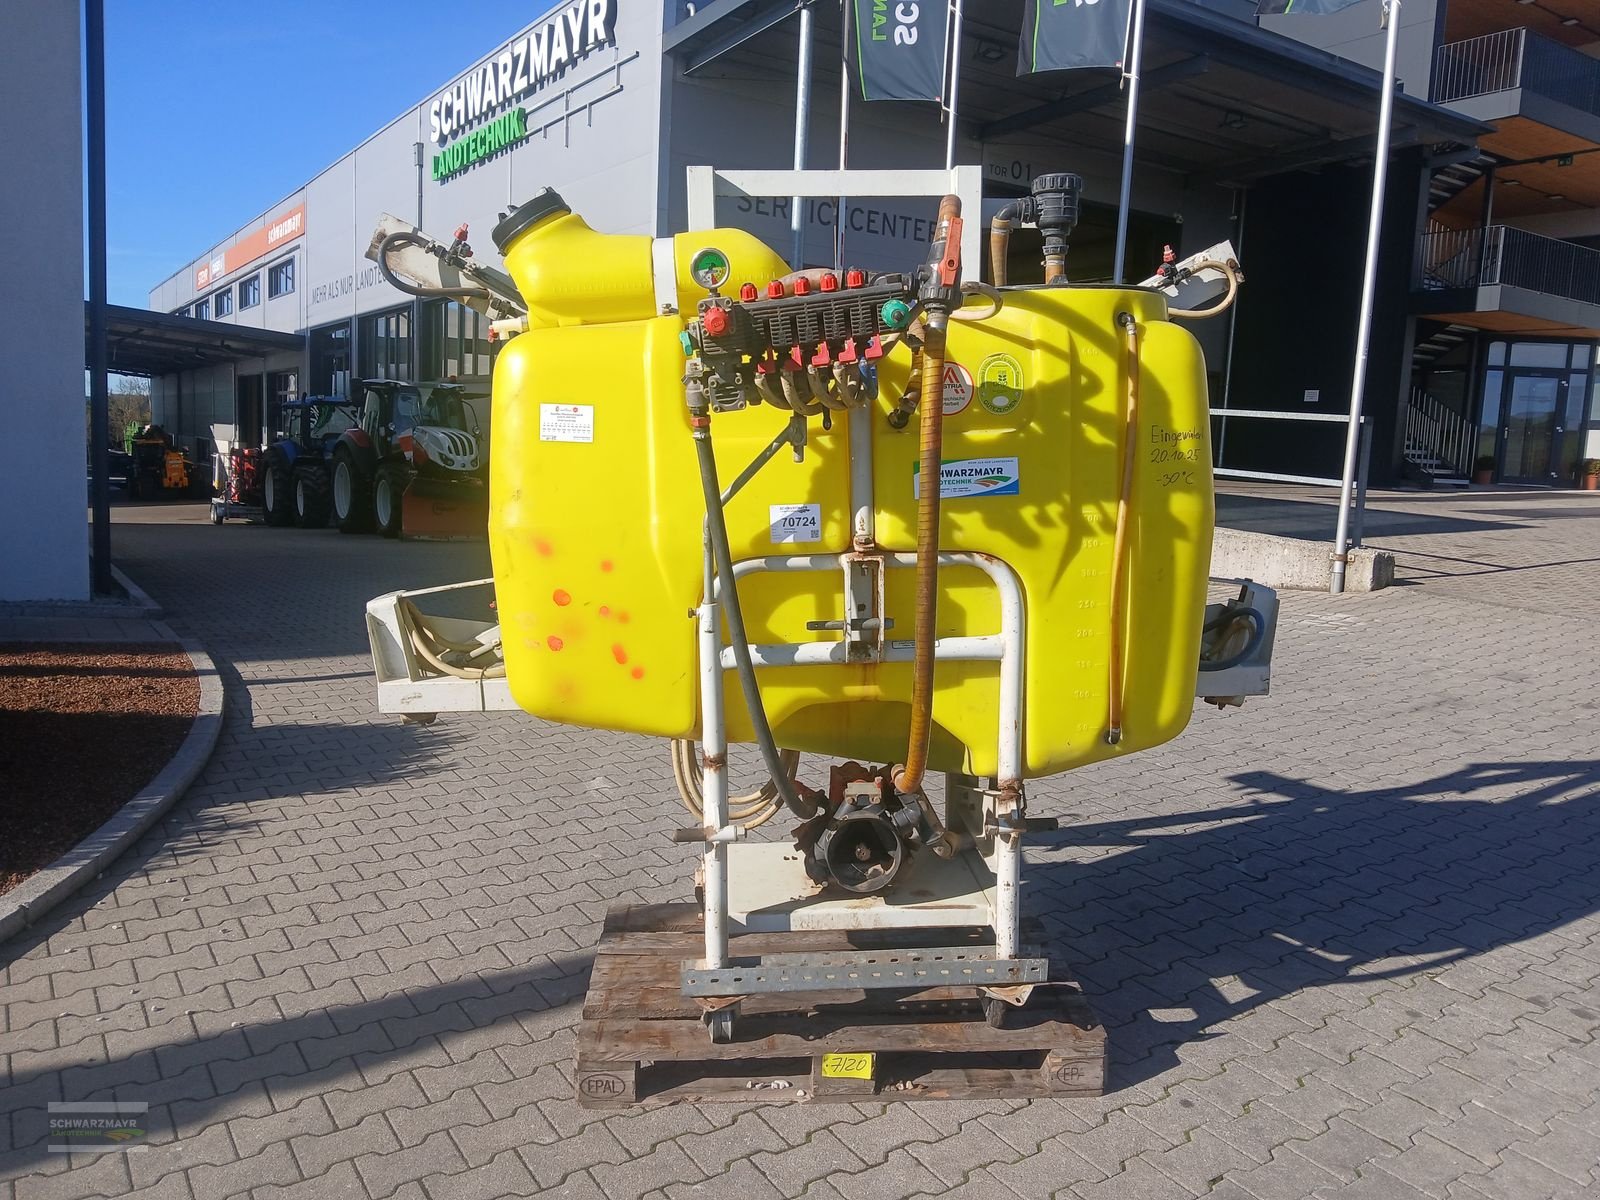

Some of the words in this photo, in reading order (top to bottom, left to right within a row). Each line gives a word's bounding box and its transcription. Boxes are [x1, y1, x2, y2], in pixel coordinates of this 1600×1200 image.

[430, 0, 607, 143] SCHWARZMAYR
[432, 108, 526, 181] LANDTECHNIK
[990, 164, 1007, 177] TOR
[1011, 160, 1030, 181] 01
[312, 284, 327, 304] MEHR
[328, 280, 338, 300] ALS
[340, 275, 353, 294] NUR
[1151, 448, 1200, 463] 20.10.25
[940, 467, 1004, 478] HWARZMAYR
[782, 516, 816, 527] 70724
[1063, 1067, 1085, 1081] EP
[588, 1078, 618, 1094] EPAL
